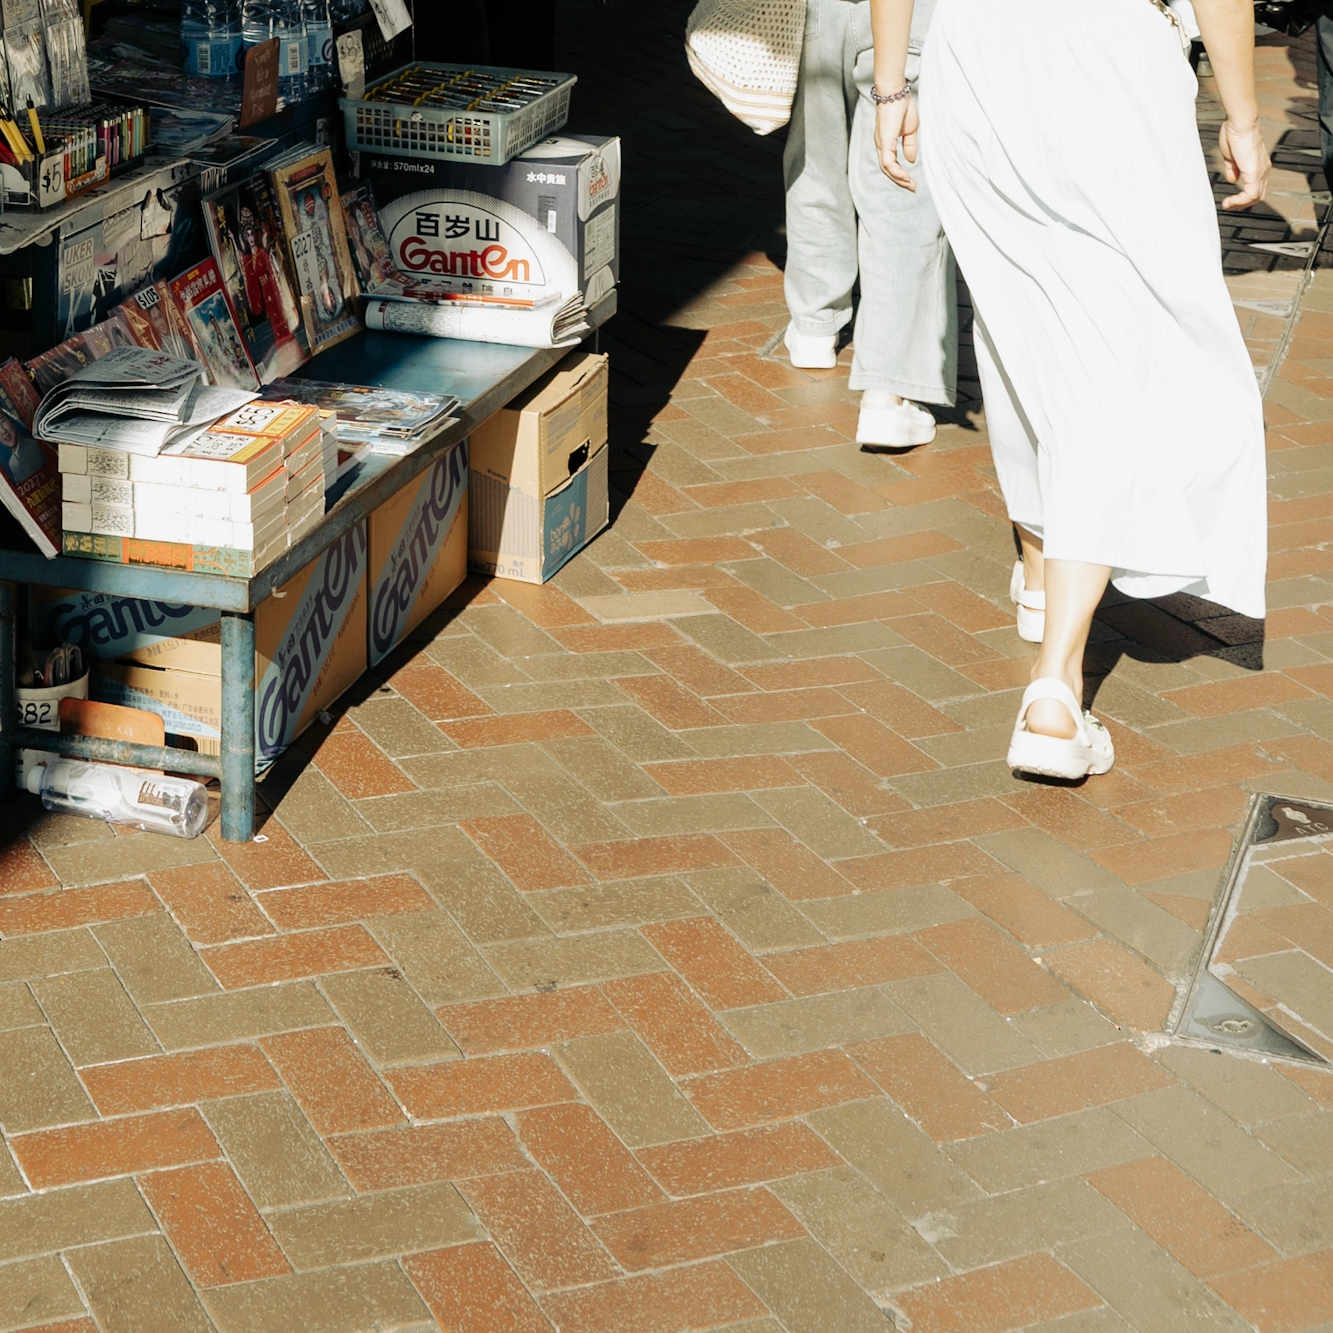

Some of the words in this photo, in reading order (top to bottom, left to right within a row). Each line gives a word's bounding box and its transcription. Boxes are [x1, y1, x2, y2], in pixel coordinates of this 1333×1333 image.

[42, 162, 61, 193] $5
[416, 212, 499, 241] 百岁山
[294, 234, 312, 258] 2027
[137, 287, 160, 308] $105
